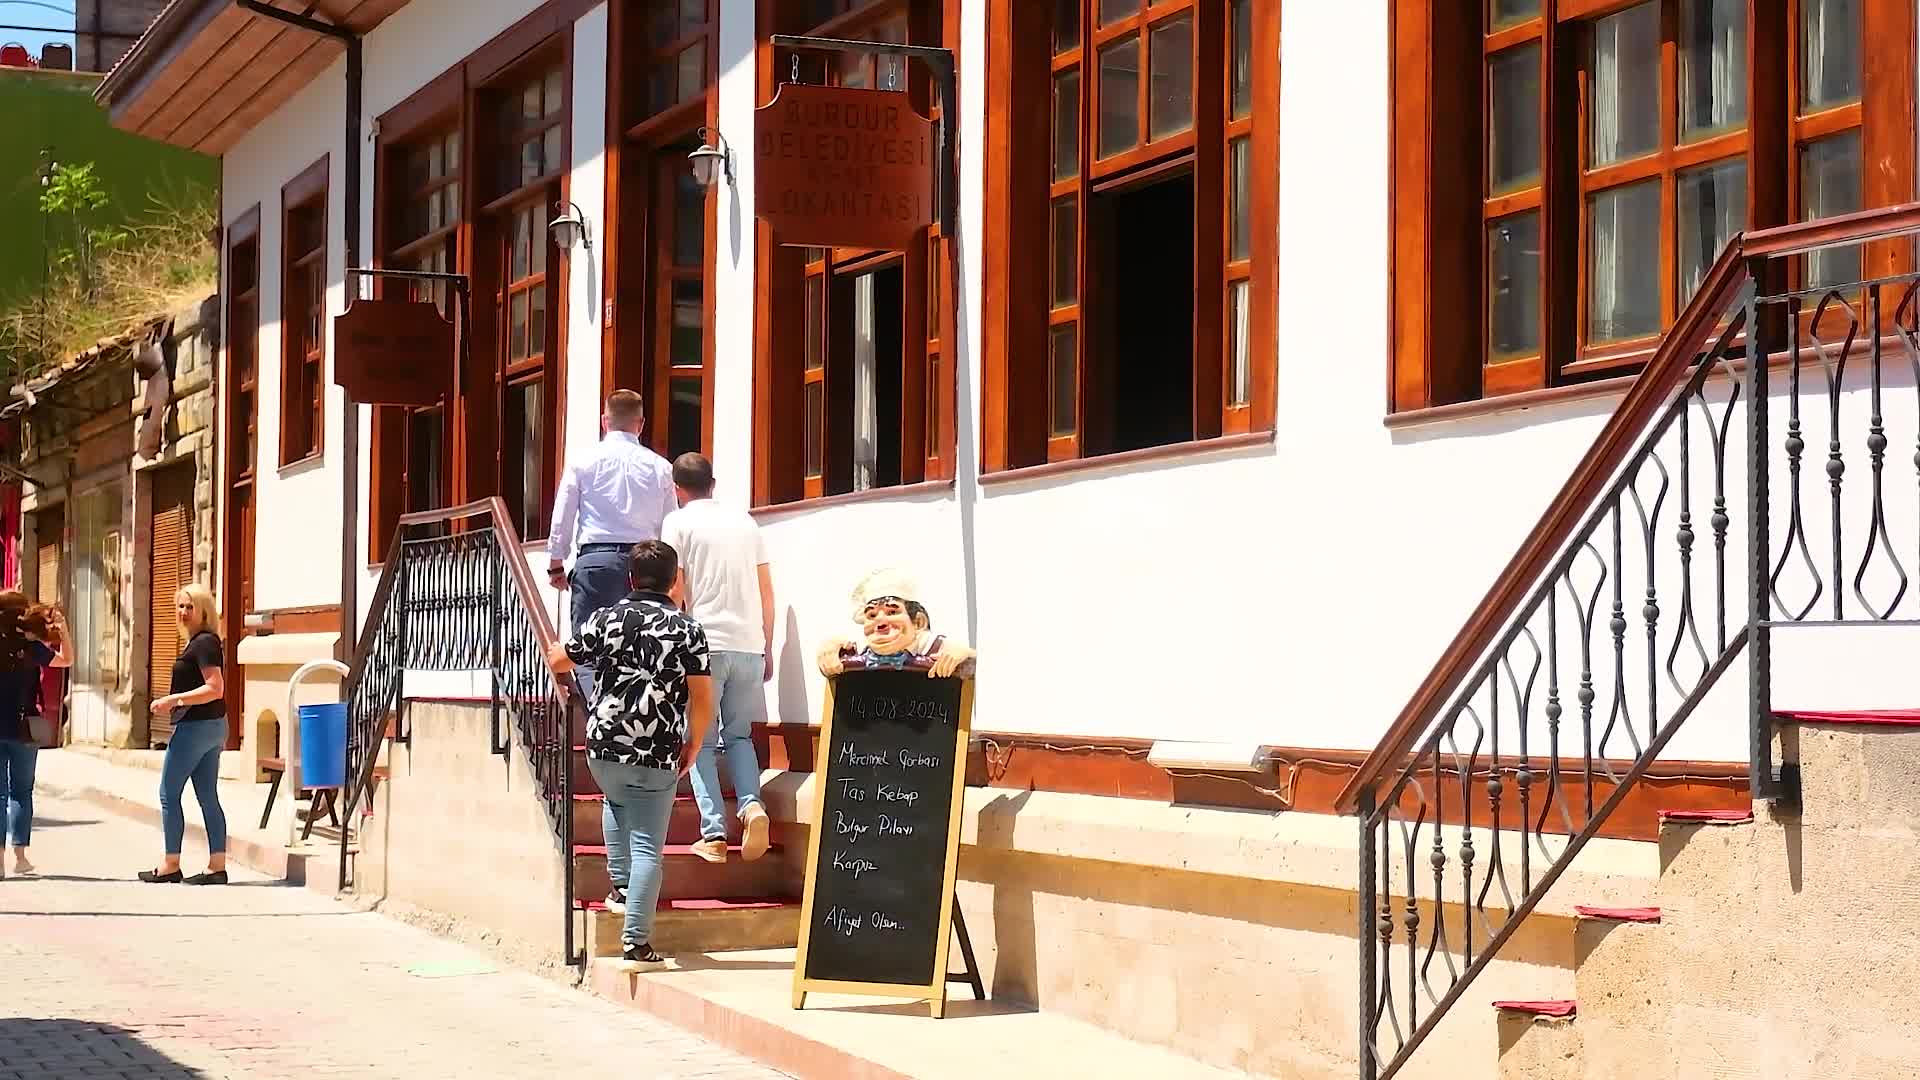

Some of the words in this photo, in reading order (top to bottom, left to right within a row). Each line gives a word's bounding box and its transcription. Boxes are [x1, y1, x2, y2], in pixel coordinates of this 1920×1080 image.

[838, 778, 865, 801] Tas
[877, 784, 919, 808] Kebap
[835, 810, 870, 843] Bulgur
[833, 850, 878, 880] Karpuz
[824, 905, 862, 936] Afiyet
